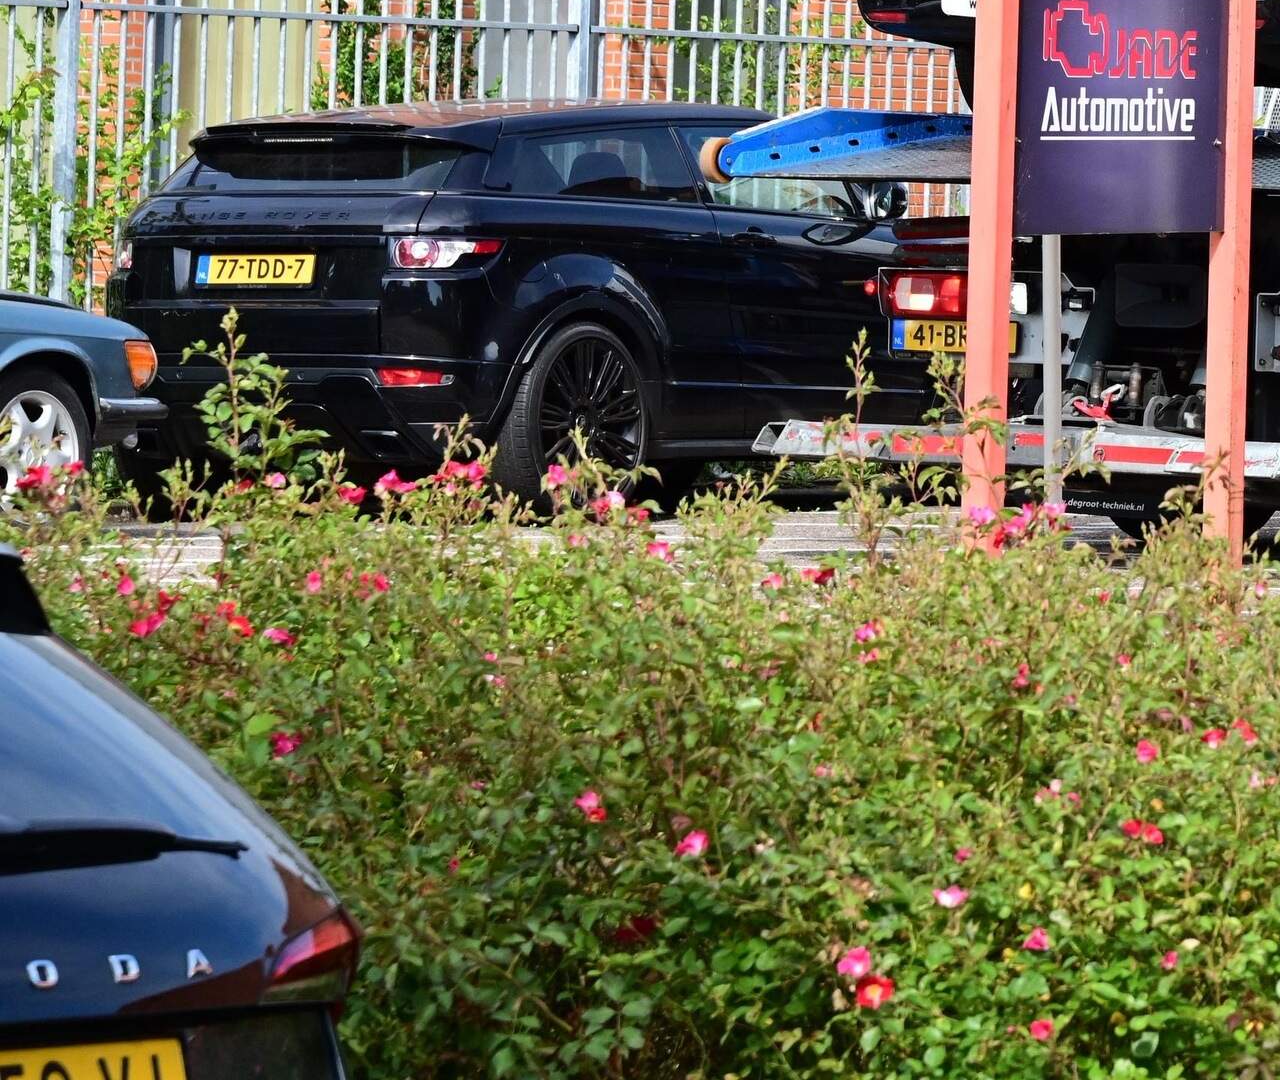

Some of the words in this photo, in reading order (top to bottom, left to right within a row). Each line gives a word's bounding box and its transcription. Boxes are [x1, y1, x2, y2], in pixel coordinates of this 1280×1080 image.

[1108, 27, 1199, 80] JADE
[1040, 86, 1196, 132] Automotive
[216, 258, 306, 280] 77-TDD-7
